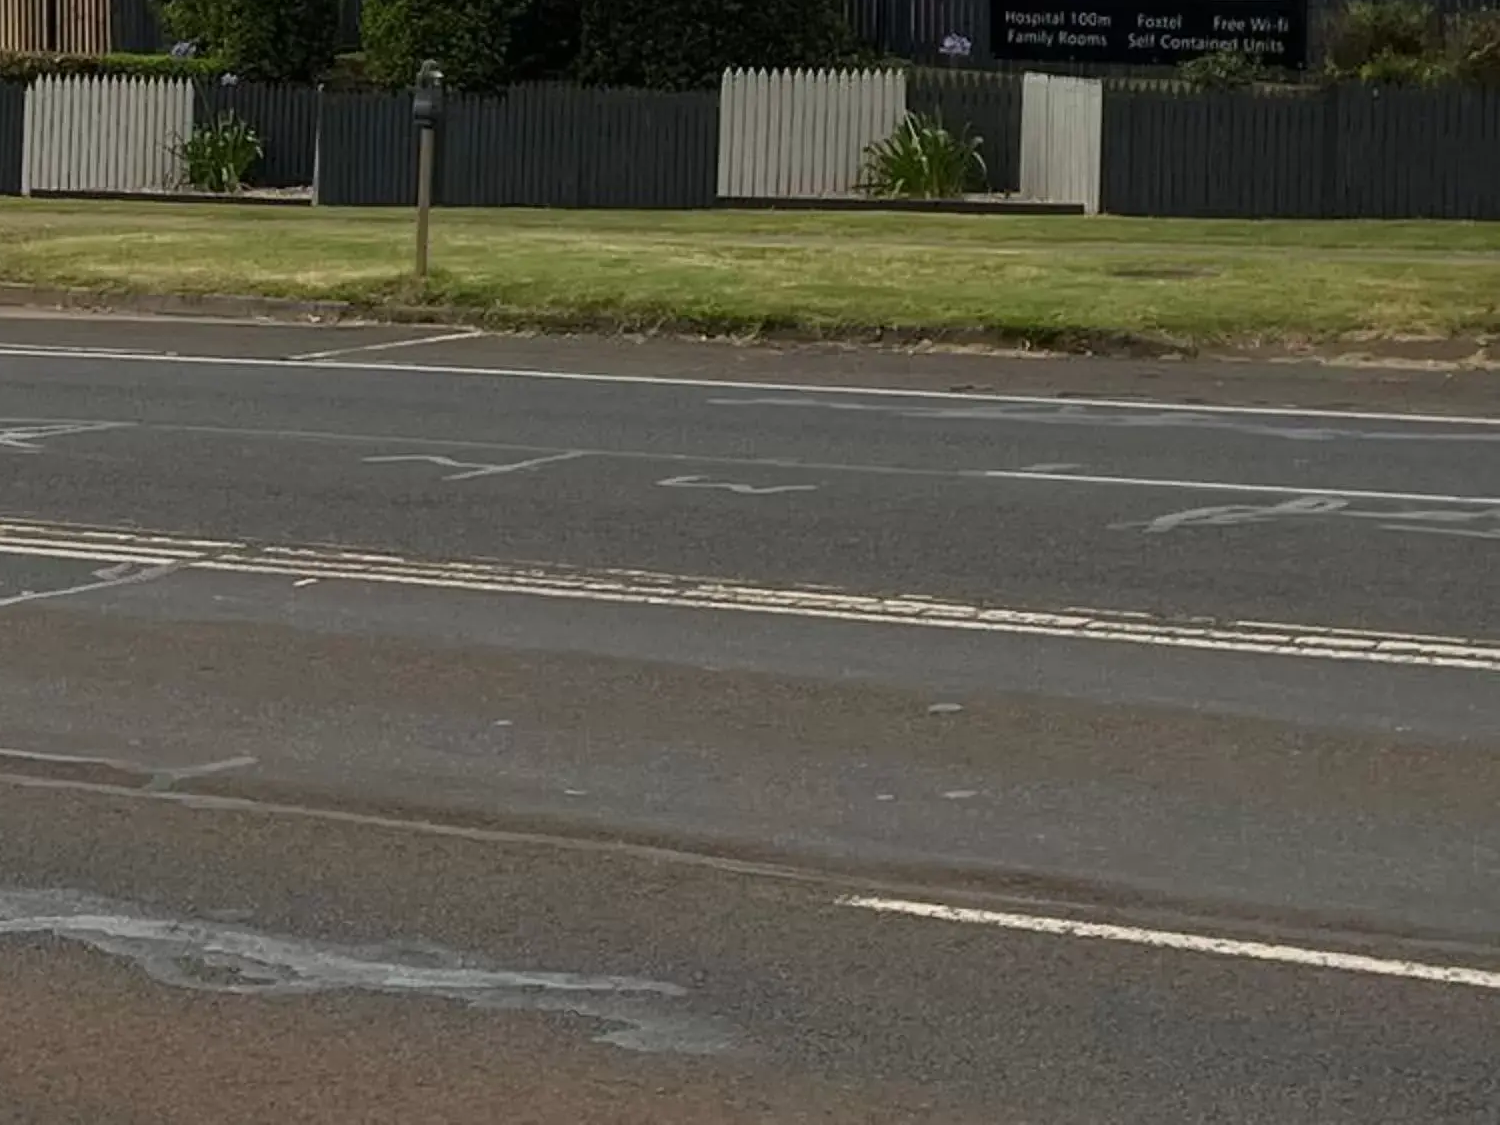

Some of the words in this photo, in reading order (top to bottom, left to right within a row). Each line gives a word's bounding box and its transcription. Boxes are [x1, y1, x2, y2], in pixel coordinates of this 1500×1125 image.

[1005, 10, 1065, 27] Hospital
[1071, 11, 1112, 27] 100m
[1137, 13, 1182, 30] Foxtel
[1213, 15, 1245, 32] Free
[1007, 29, 1053, 48] Family
[1059, 30, 1108, 47] Rooms
[1128, 32, 1155, 49] Self
[1160, 34, 1238, 52] Contained
[1243, 38, 1284, 55] Units
